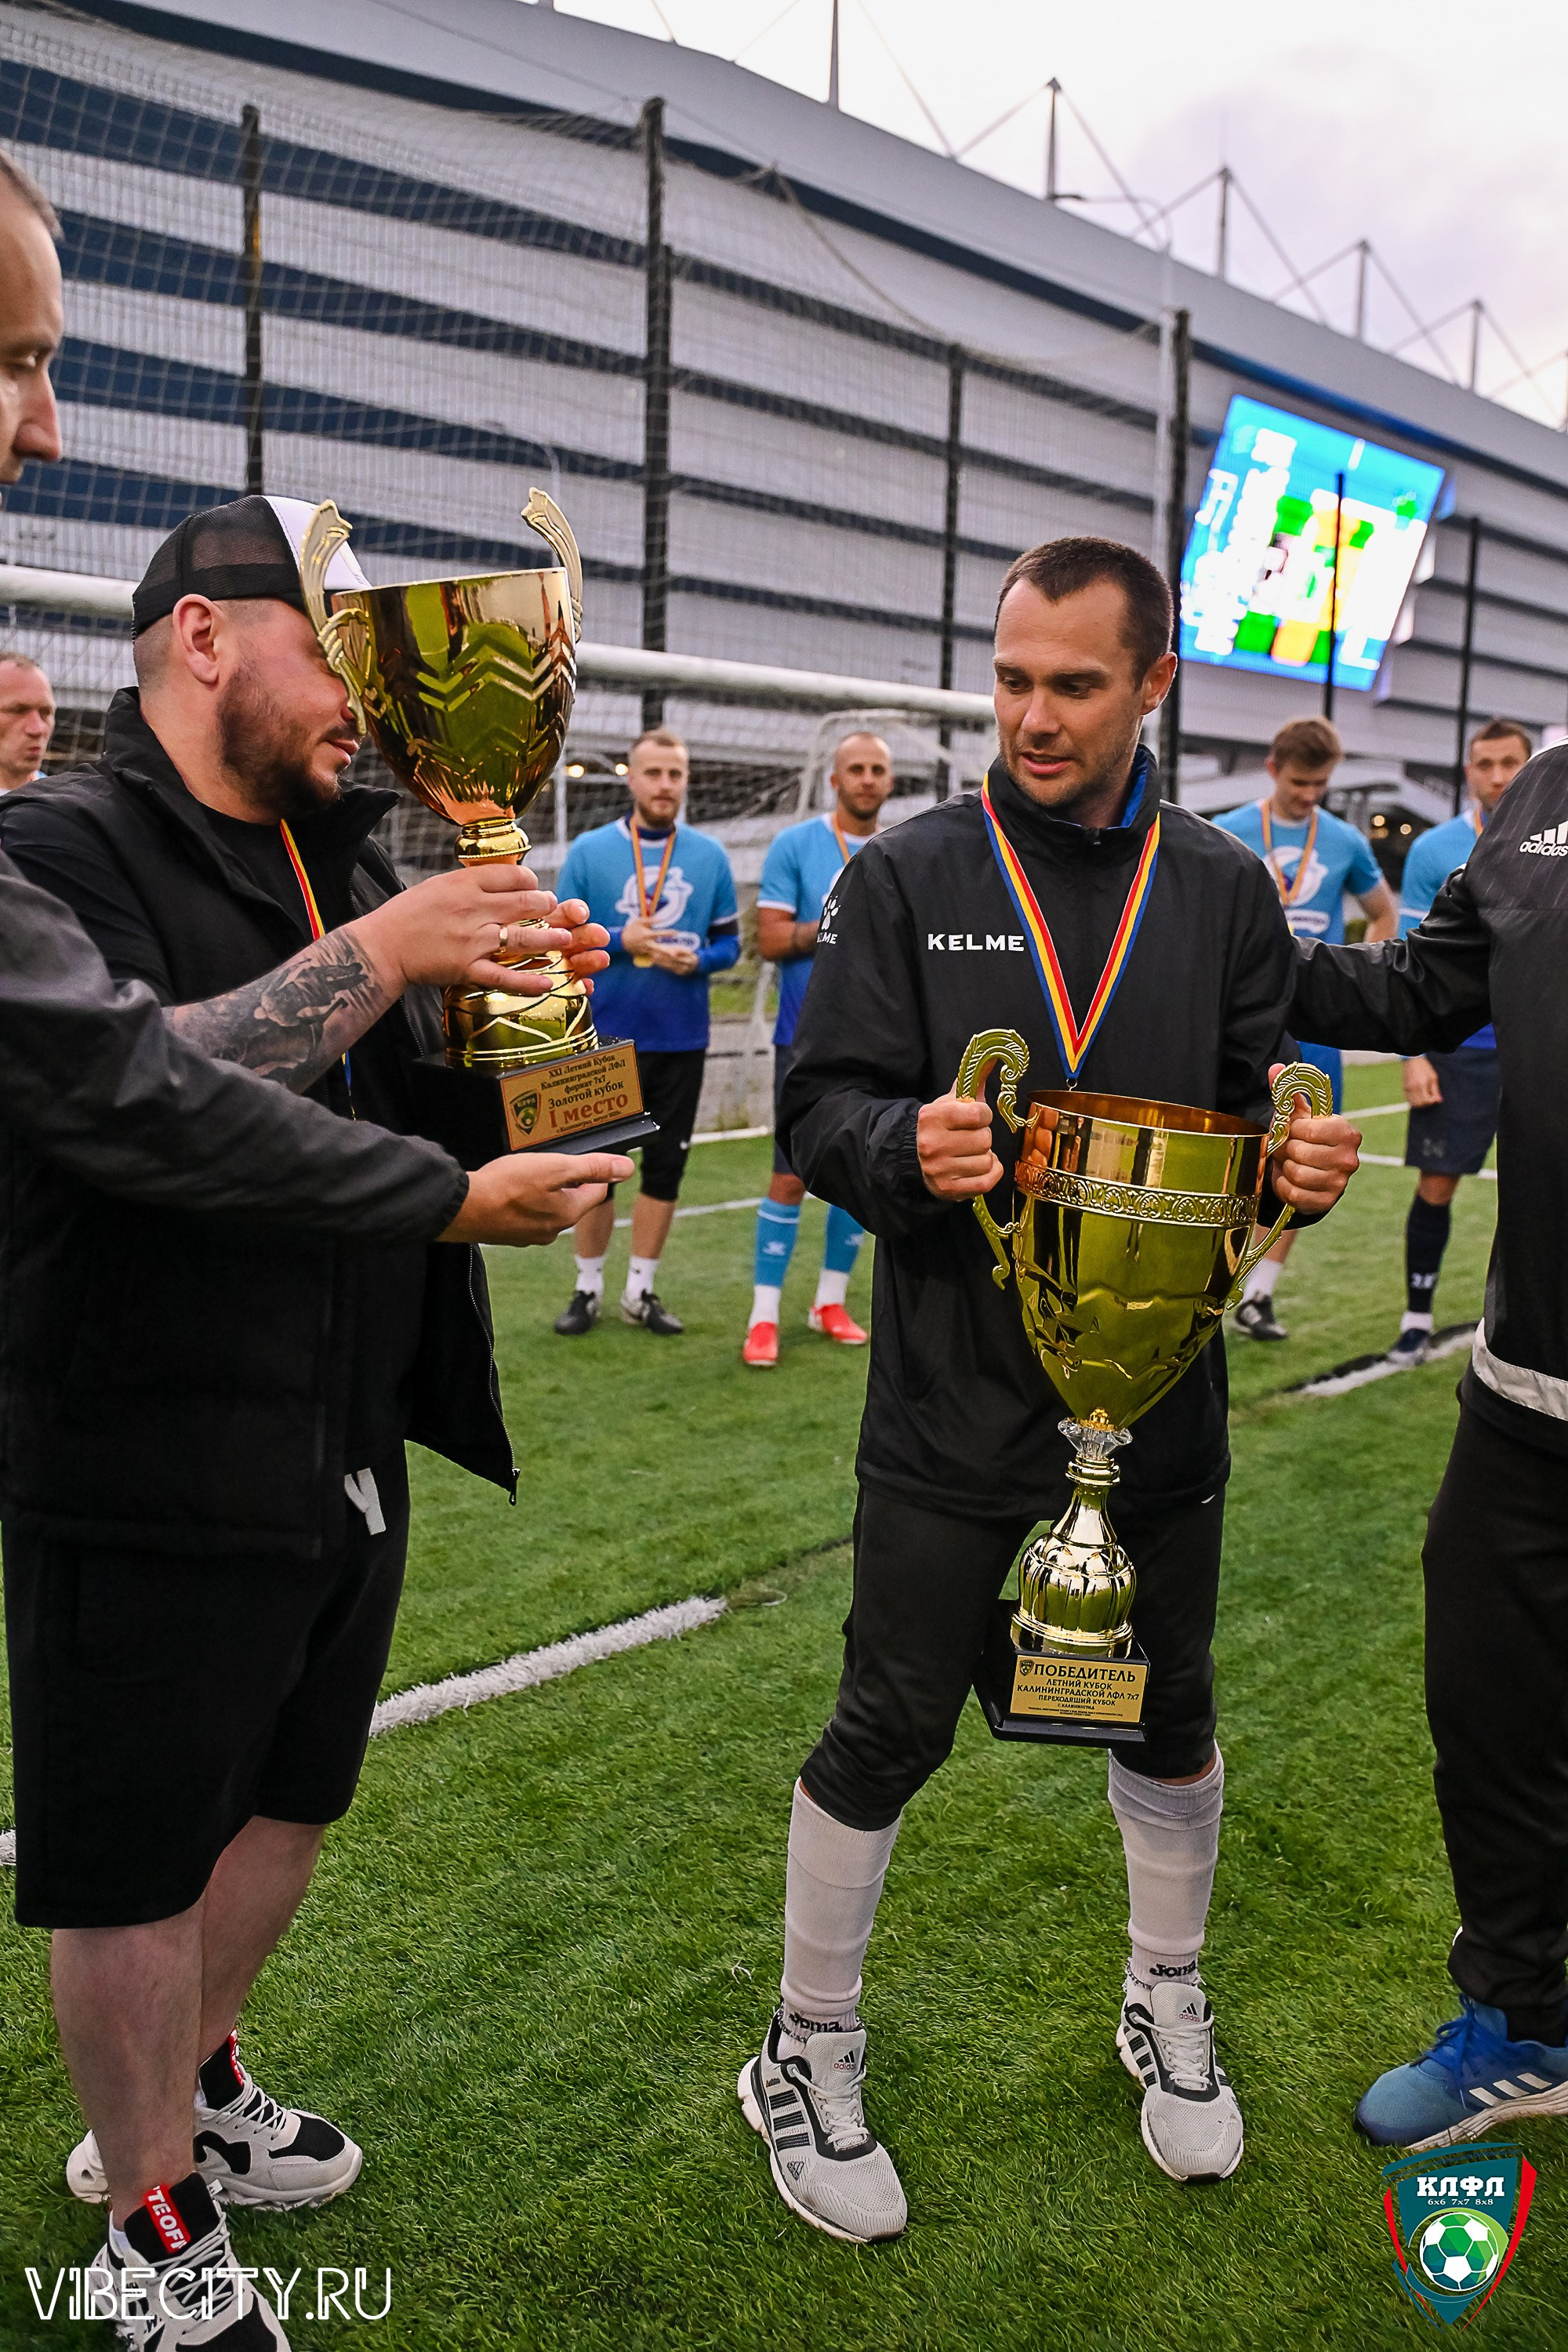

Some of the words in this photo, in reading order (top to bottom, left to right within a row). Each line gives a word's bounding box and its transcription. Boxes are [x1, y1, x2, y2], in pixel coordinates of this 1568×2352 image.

[1519, 840, 1568, 857] adidas
[927, 933, 1025, 952] KELME
[564, 1061, 592, 1074] Летний
[593, 1054, 616, 1066] Кубок
[541, 1065, 607, 1091] Калининградской
[608, 1059, 626, 1072] ЛФЛ
[548, 1088, 592, 1109] Золотой
[594, 1081, 624, 1098] кубок
[564, 1080, 592, 1094] формат
[563, 1094, 629, 1124] место
[1033, 1664, 1136, 1682] ПОБЕДИТЕЛЬ
[1017, 1684, 1105, 1698] КАЛИНИНГРАДСКОЙ
[1106, 1691, 1125, 1700] ЛФЛ
[1046, 1679, 1081, 1688] ЛЕТНИЙ
[1083, 1682, 1112, 1690] КУБОК
[1038, 1694, 1091, 1704] ПЕРЕХОДЯЩИЙ
[1178, 2013, 1200, 2023] adidas
[833, 2062, 856, 2071] adidas
